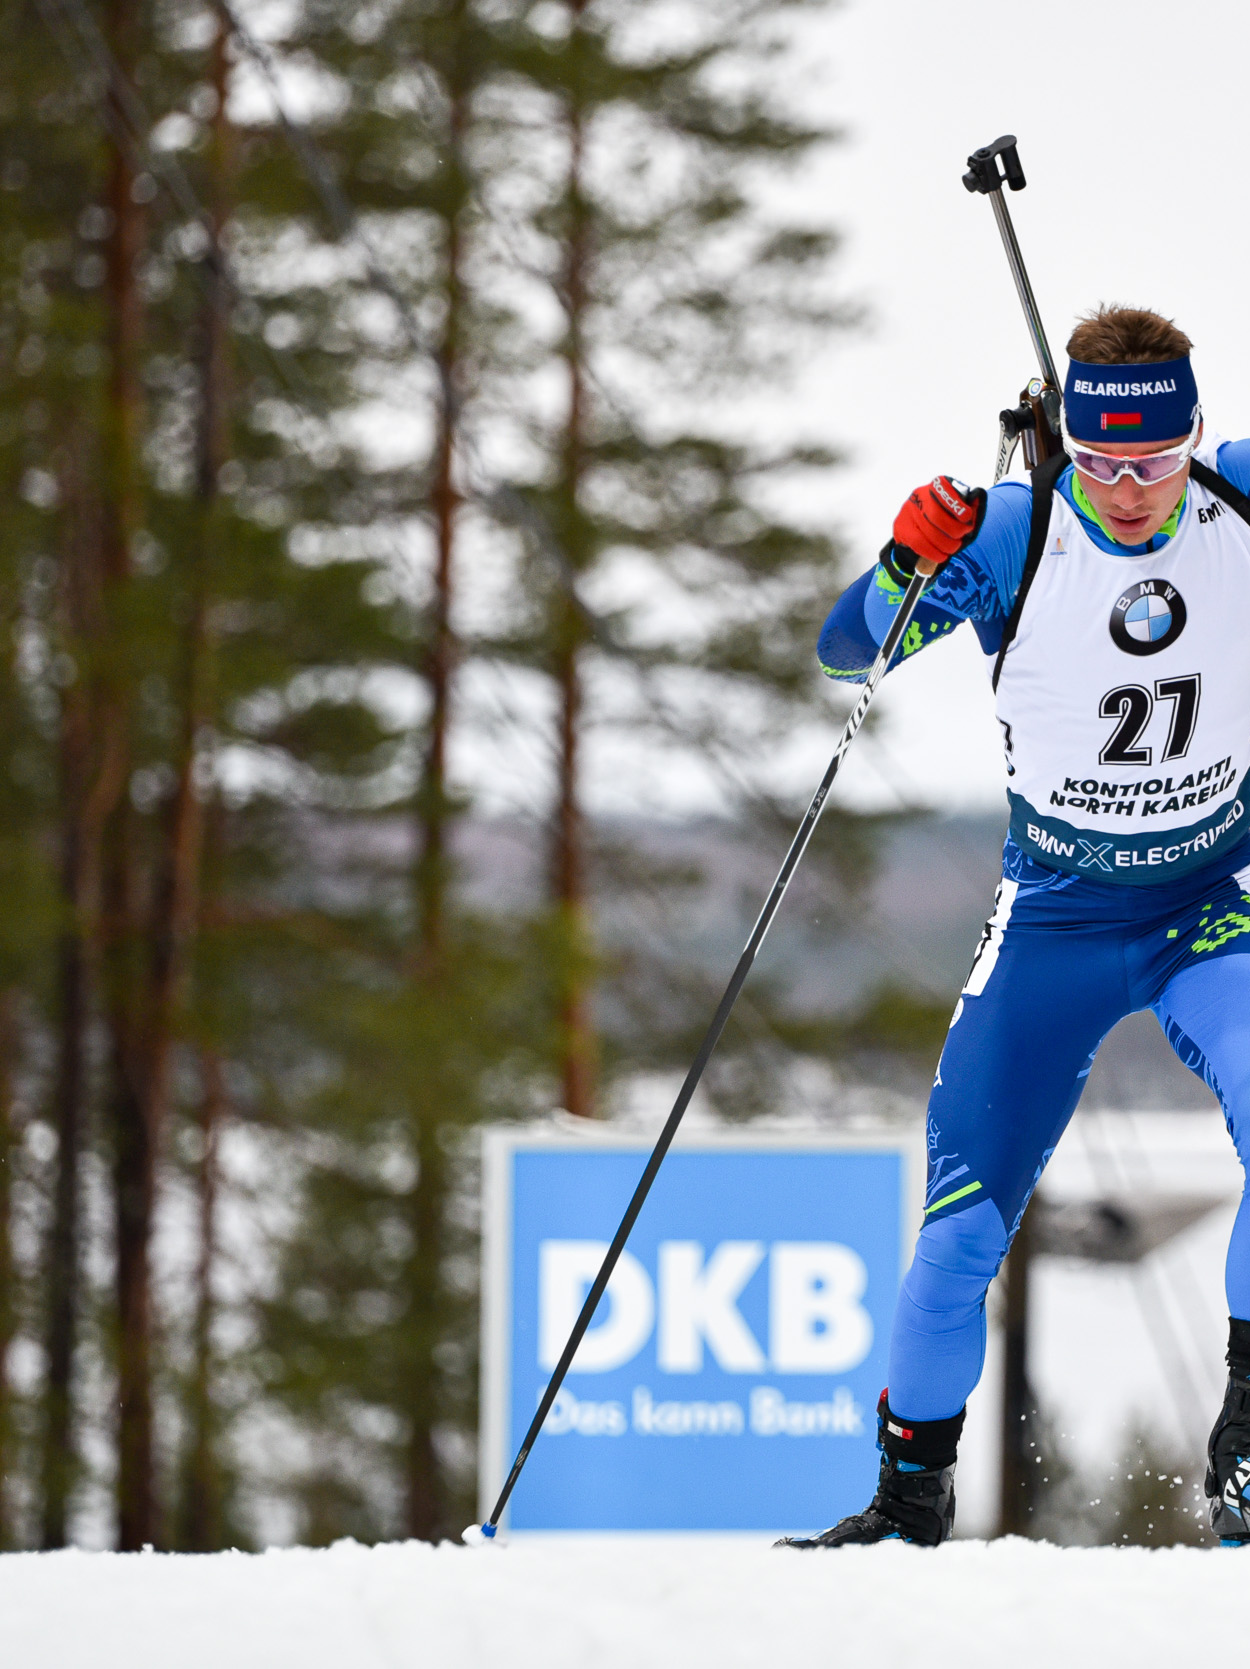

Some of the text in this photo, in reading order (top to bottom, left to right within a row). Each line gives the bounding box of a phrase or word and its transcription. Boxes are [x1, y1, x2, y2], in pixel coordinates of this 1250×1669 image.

[1073, 379, 1177, 397] BELARUSKALI
[1115, 581, 1177, 612] BMW
[1098, 672, 1202, 767] 27
[1050, 768, 1237, 817] NORTH KARELIA
[1063, 755, 1233, 799] KONTIOLAHTI
[1026, 822, 1076, 858] BMW
[538, 1239, 875, 1375] DKB
[536, 1385, 628, 1437] Das
[750, 1385, 866, 1437] Bank
